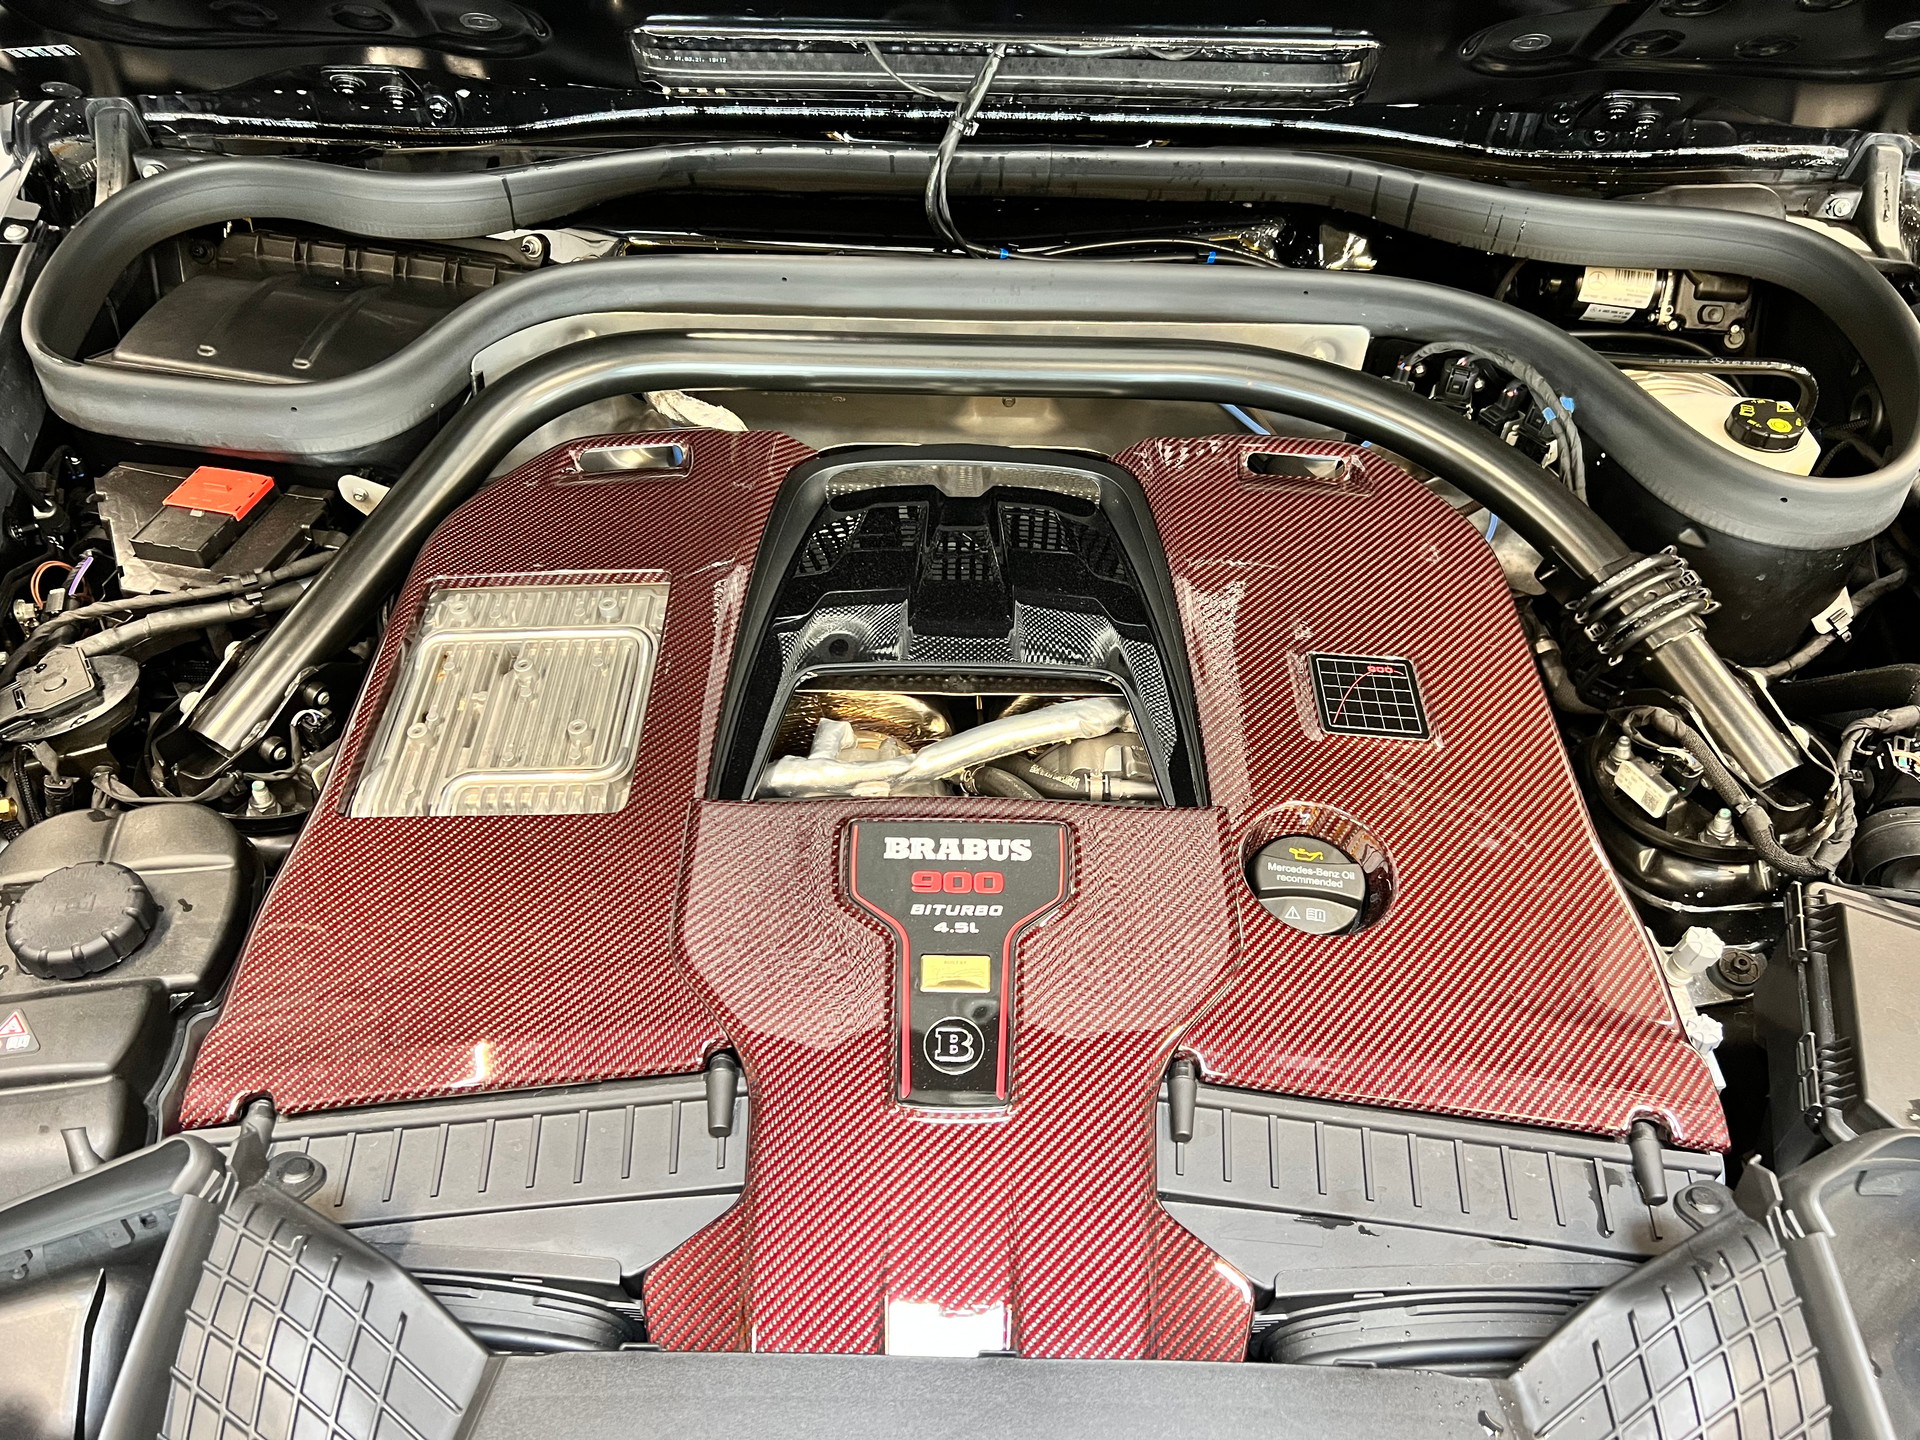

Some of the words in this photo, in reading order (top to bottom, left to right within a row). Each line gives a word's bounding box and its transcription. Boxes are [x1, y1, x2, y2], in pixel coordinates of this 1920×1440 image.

[883, 837, 1033, 862] BRABUS
[1267, 862, 1340, 879] Mercedes-Benz
[1341, 870, 1355, 880] Oil
[911, 870, 1004, 894] 900
[1276, 874, 1343, 888] recommended
[910, 904, 1003, 916] BITURBO
[933, 922, 980, 934] 4.5L
[935, 1027, 975, 1062] B
